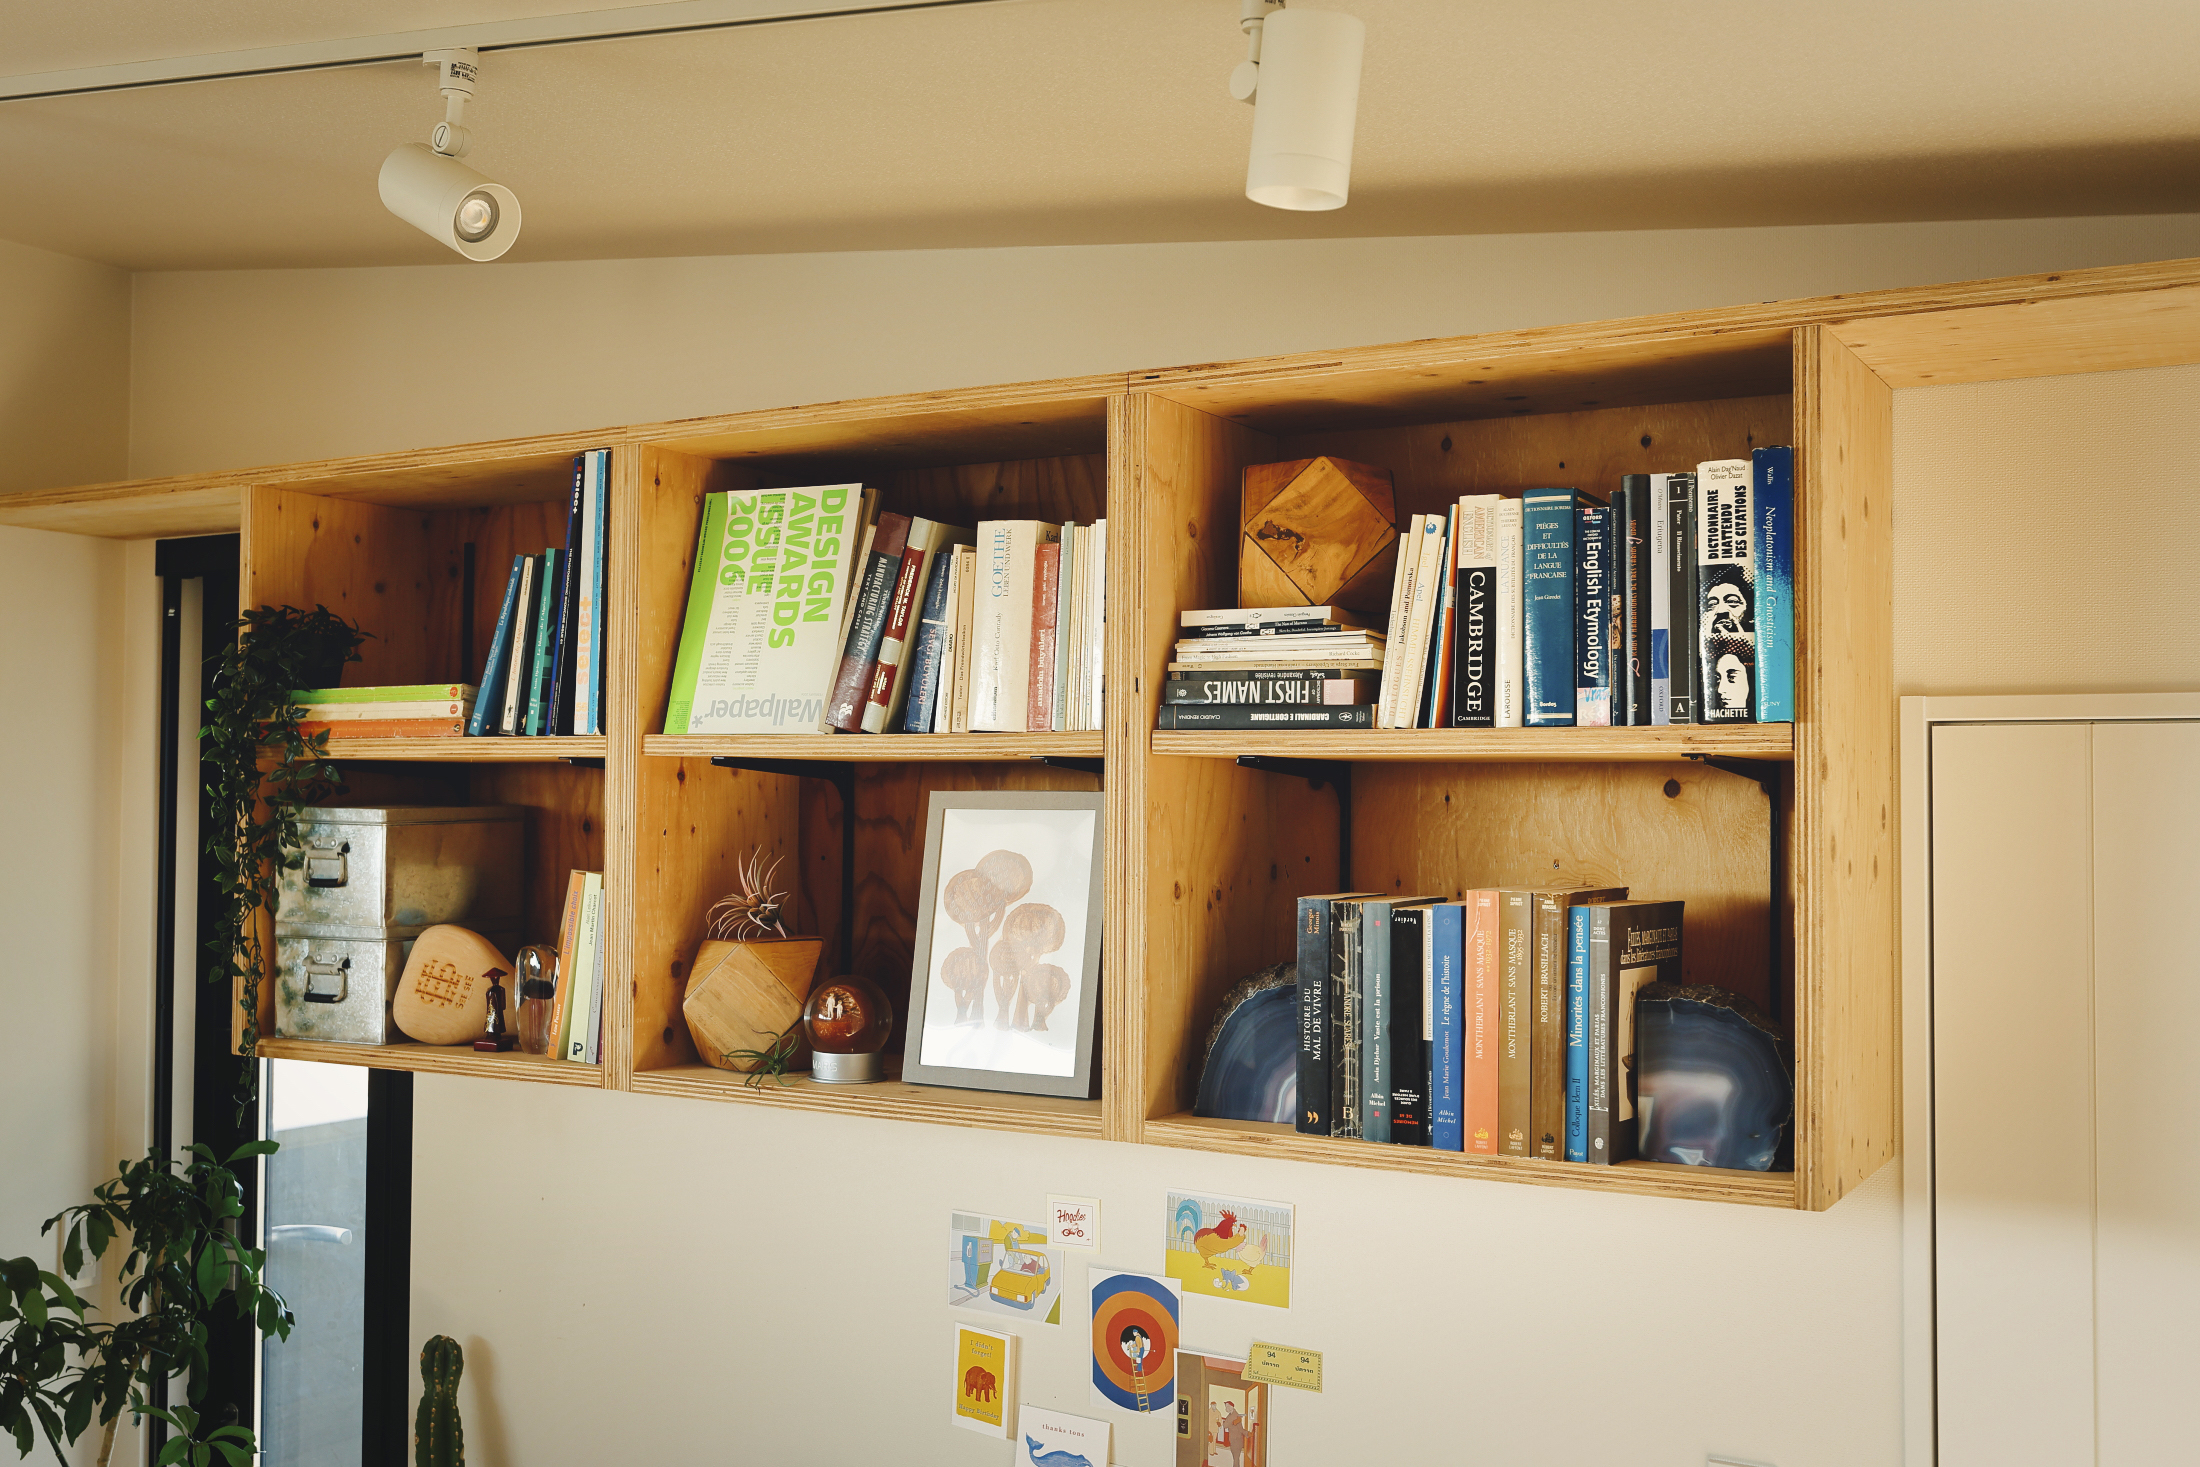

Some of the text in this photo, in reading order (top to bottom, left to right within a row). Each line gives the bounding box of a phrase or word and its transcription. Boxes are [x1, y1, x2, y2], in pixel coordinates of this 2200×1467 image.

[719, 496, 757, 586] 2006
[1046, 530, 1059, 542] Karl
[1462, 510, 1473, 555] ENGLISH
[1473, 506, 1485, 559] AMERICAN
[1536, 522, 1559, 530] PIÈGES
[1656, 520, 1664, 553] Eriugena
[1708, 489, 1719, 560] DICTIONNAIRE
[1721, 503, 1733, 558] INATTENDU
[1735, 485, 1747, 558] DES CITATIONS
[746, 493, 786, 595] ISSUE
[803, 488, 848, 622] DESIGN
[991, 528, 1005, 598] GOETHE
[1422, 552, 1431, 568] Igel
[1500, 536, 1510, 594] LA NUANCE
[1527, 541, 1569, 550] DIFFICULTÉS
[768, 492, 817, 649] AWARDS
[864, 574, 872, 591] TEXT
[866, 557, 888, 621] MANUFACTURING
[905, 565, 916, 597] FREDERICK
[1583, 542, 1601, 595] English
[1762, 506, 1777, 648] Neoplatonism and Gnosticism
[1399, 615, 1408, 644] Jakobson
[1405, 567, 1414, 600] Pomorska
[1416, 582, 1425, 602] Apel
[854, 609, 863, 630] CASES
[898, 605, 907, 627] TAYLOR
[995, 612, 1003, 639] Conrady
[856, 622, 873, 656] STRATEGY
[1467, 571, 1486, 712] CAMBRIDGE
[1583, 599, 1602, 679] Etymology
[1389, 655, 1403, 717] DIALOGUES
[1398, 618, 1420, 720] HIMMELSSEHNSUCHT
[1203, 681, 1310, 704] FIRST NAMES
[1675, 703, 1685, 713] A
[1710, 708, 1748, 718] HACHETTE
[564, 912, 576, 955] L'impossible
[1395, 916, 1417, 924] Verdier
[1304, 987, 1311, 1002] DU
[1442, 955, 1452, 1026] Le règne de l'histoire
[1570, 915, 1586, 1047] Minorités dans la pensée
[1312, 980, 1322, 1061] MAL DE VIVRE
[1572, 1104, 1580, 1137] Colloque
[971, 1348, 992, 1358] forget!
[976, 1341, 993, 1350] didn't
[959, 1404, 999, 1420] Happy Birthday
[1042, 1424, 1085, 1437] thanks tons
